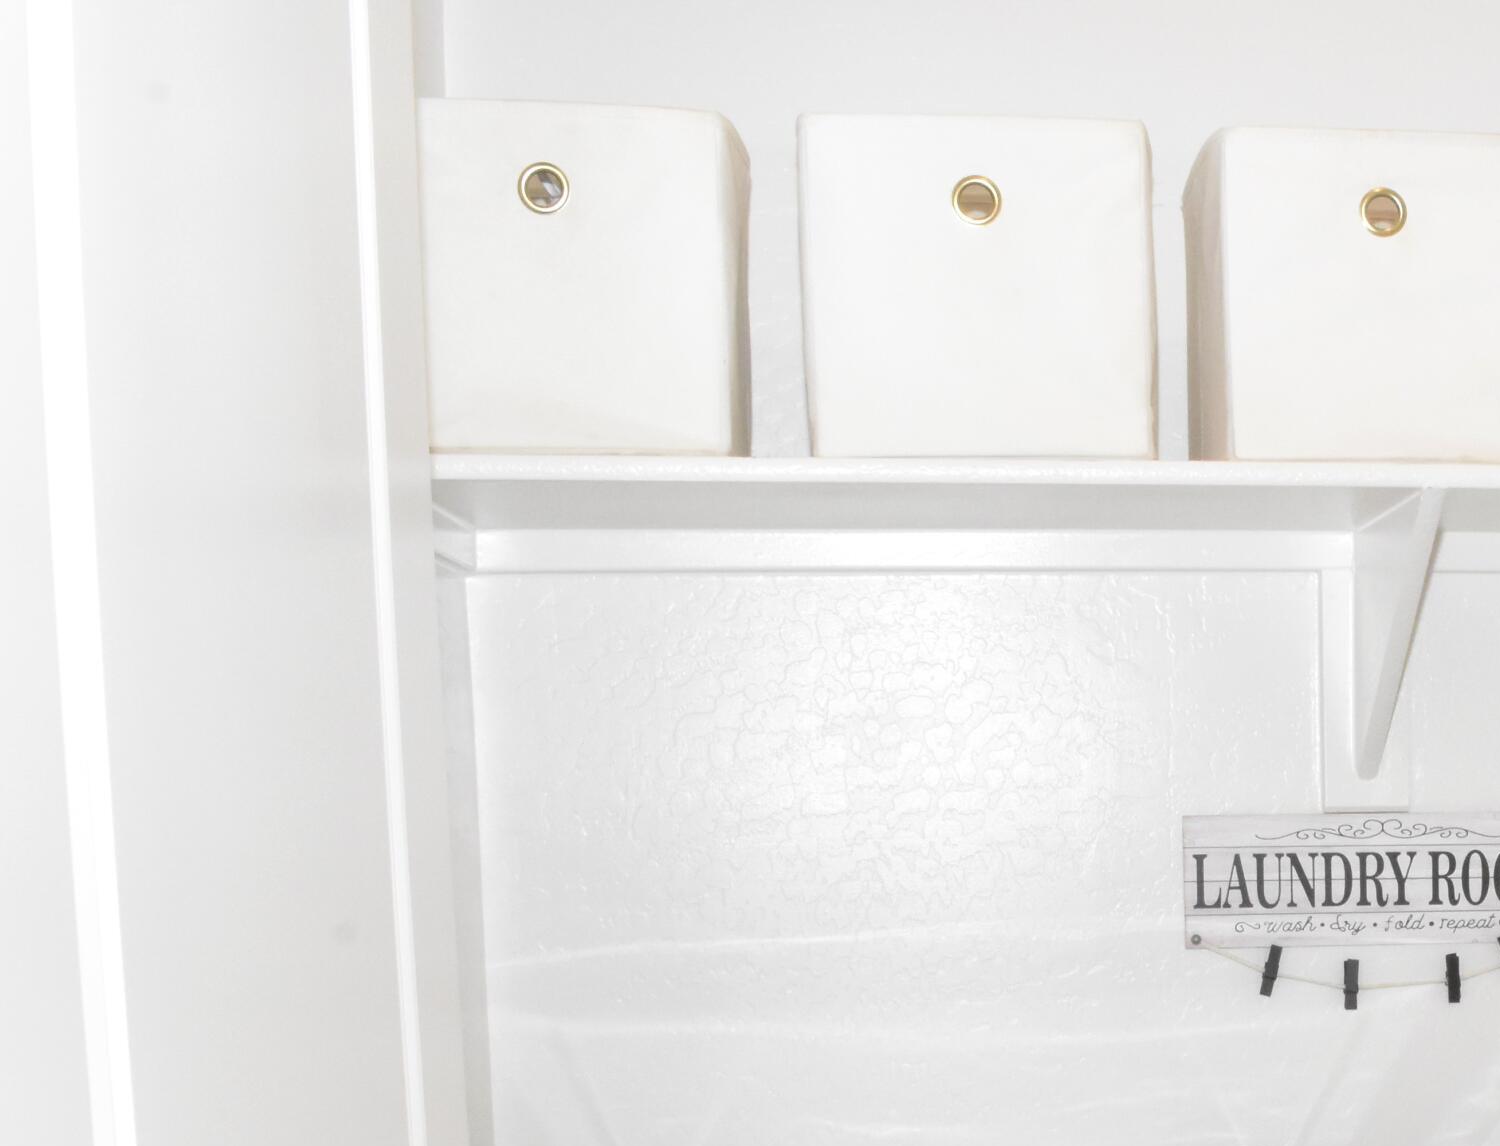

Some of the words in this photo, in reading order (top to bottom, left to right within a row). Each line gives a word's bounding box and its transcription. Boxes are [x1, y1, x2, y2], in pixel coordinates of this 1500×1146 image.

[1193, 850, 1417, 910] LAUNDRY
[1263, 915, 1317, 933] wash
[1330, 913, 1366, 936] dry
[1384, 913, 1425, 932] fold
[1439, 913, 1495, 934] repeat
